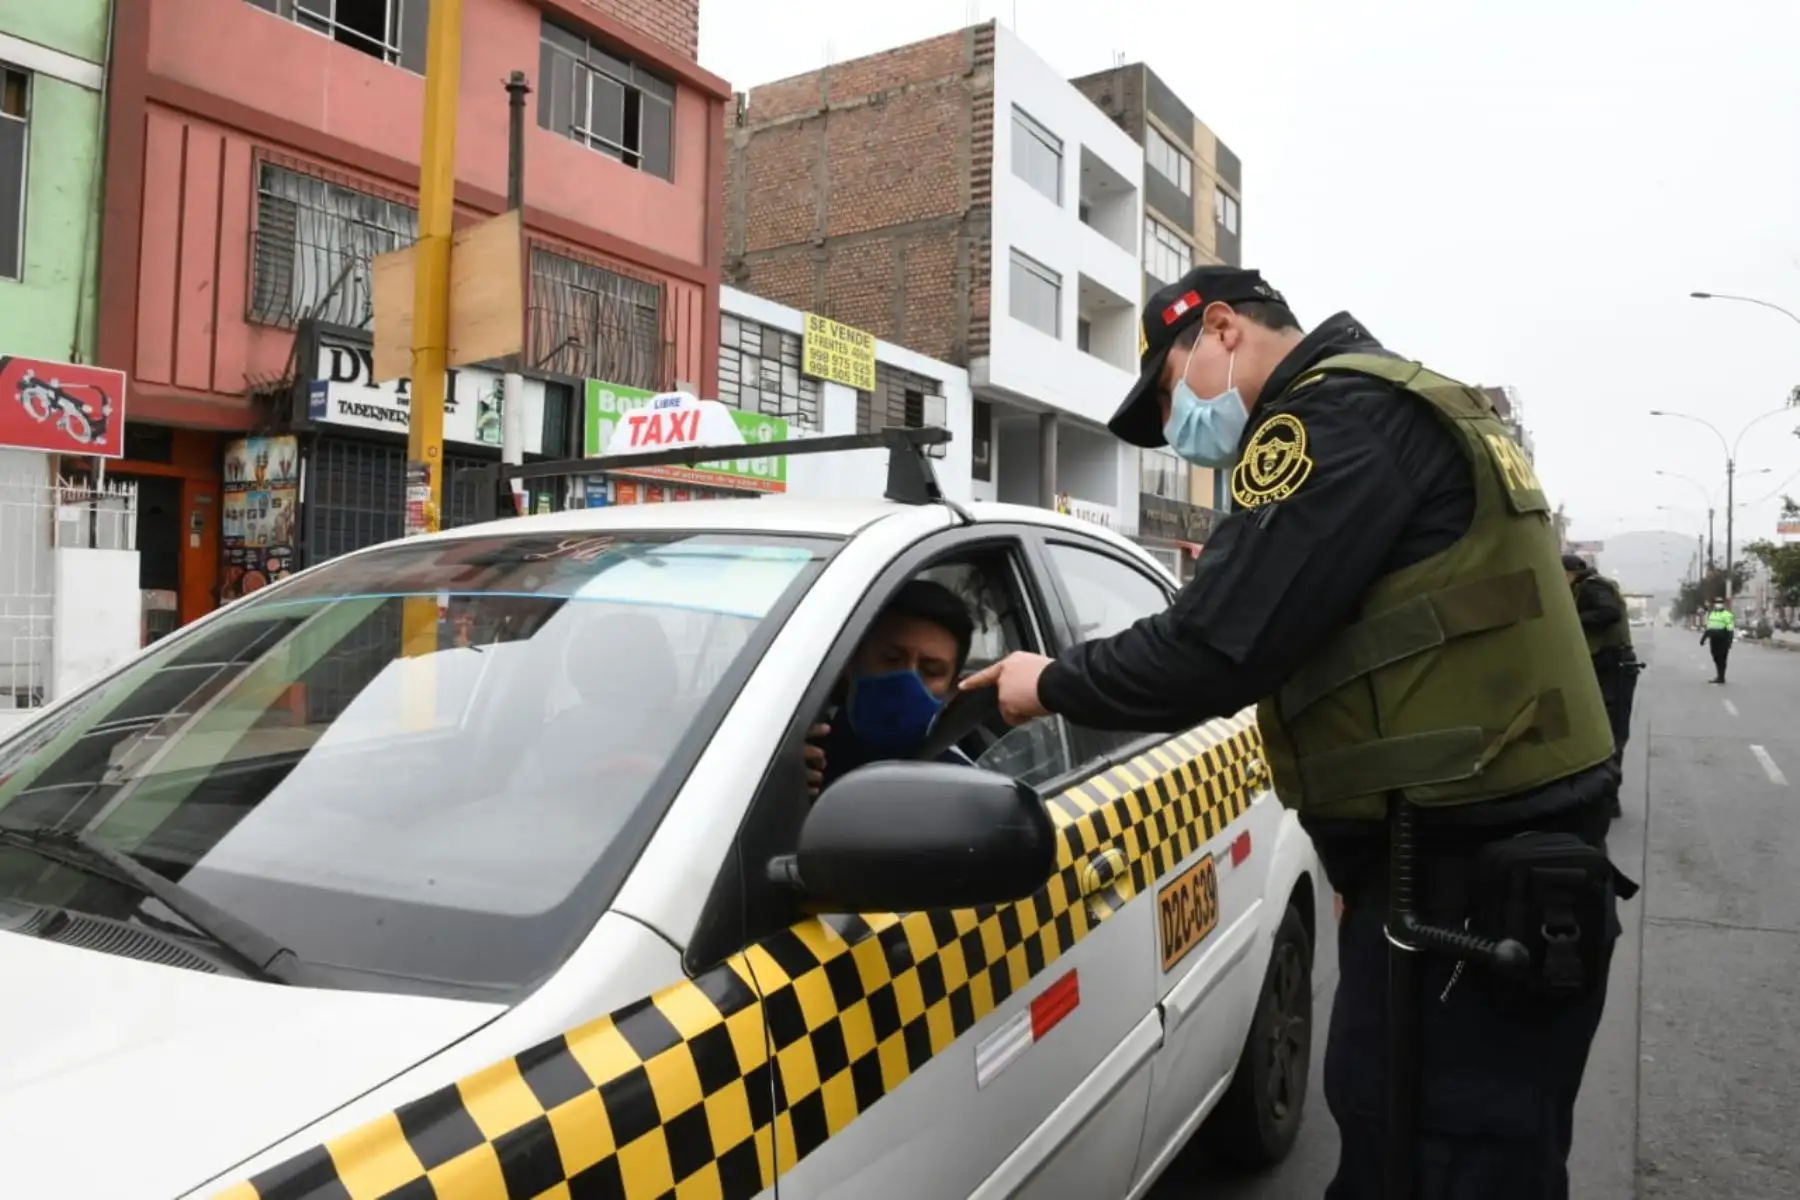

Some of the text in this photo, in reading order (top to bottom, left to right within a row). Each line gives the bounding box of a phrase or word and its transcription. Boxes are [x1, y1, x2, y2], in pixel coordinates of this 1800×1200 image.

[810, 316, 871, 349] SE VENDE
[338, 400, 410, 425] TABERNER
[654, 397, 681, 409] LIBRE
[628, 408, 702, 447] TAXI
[1161, 862, 1217, 960] D2C-639
